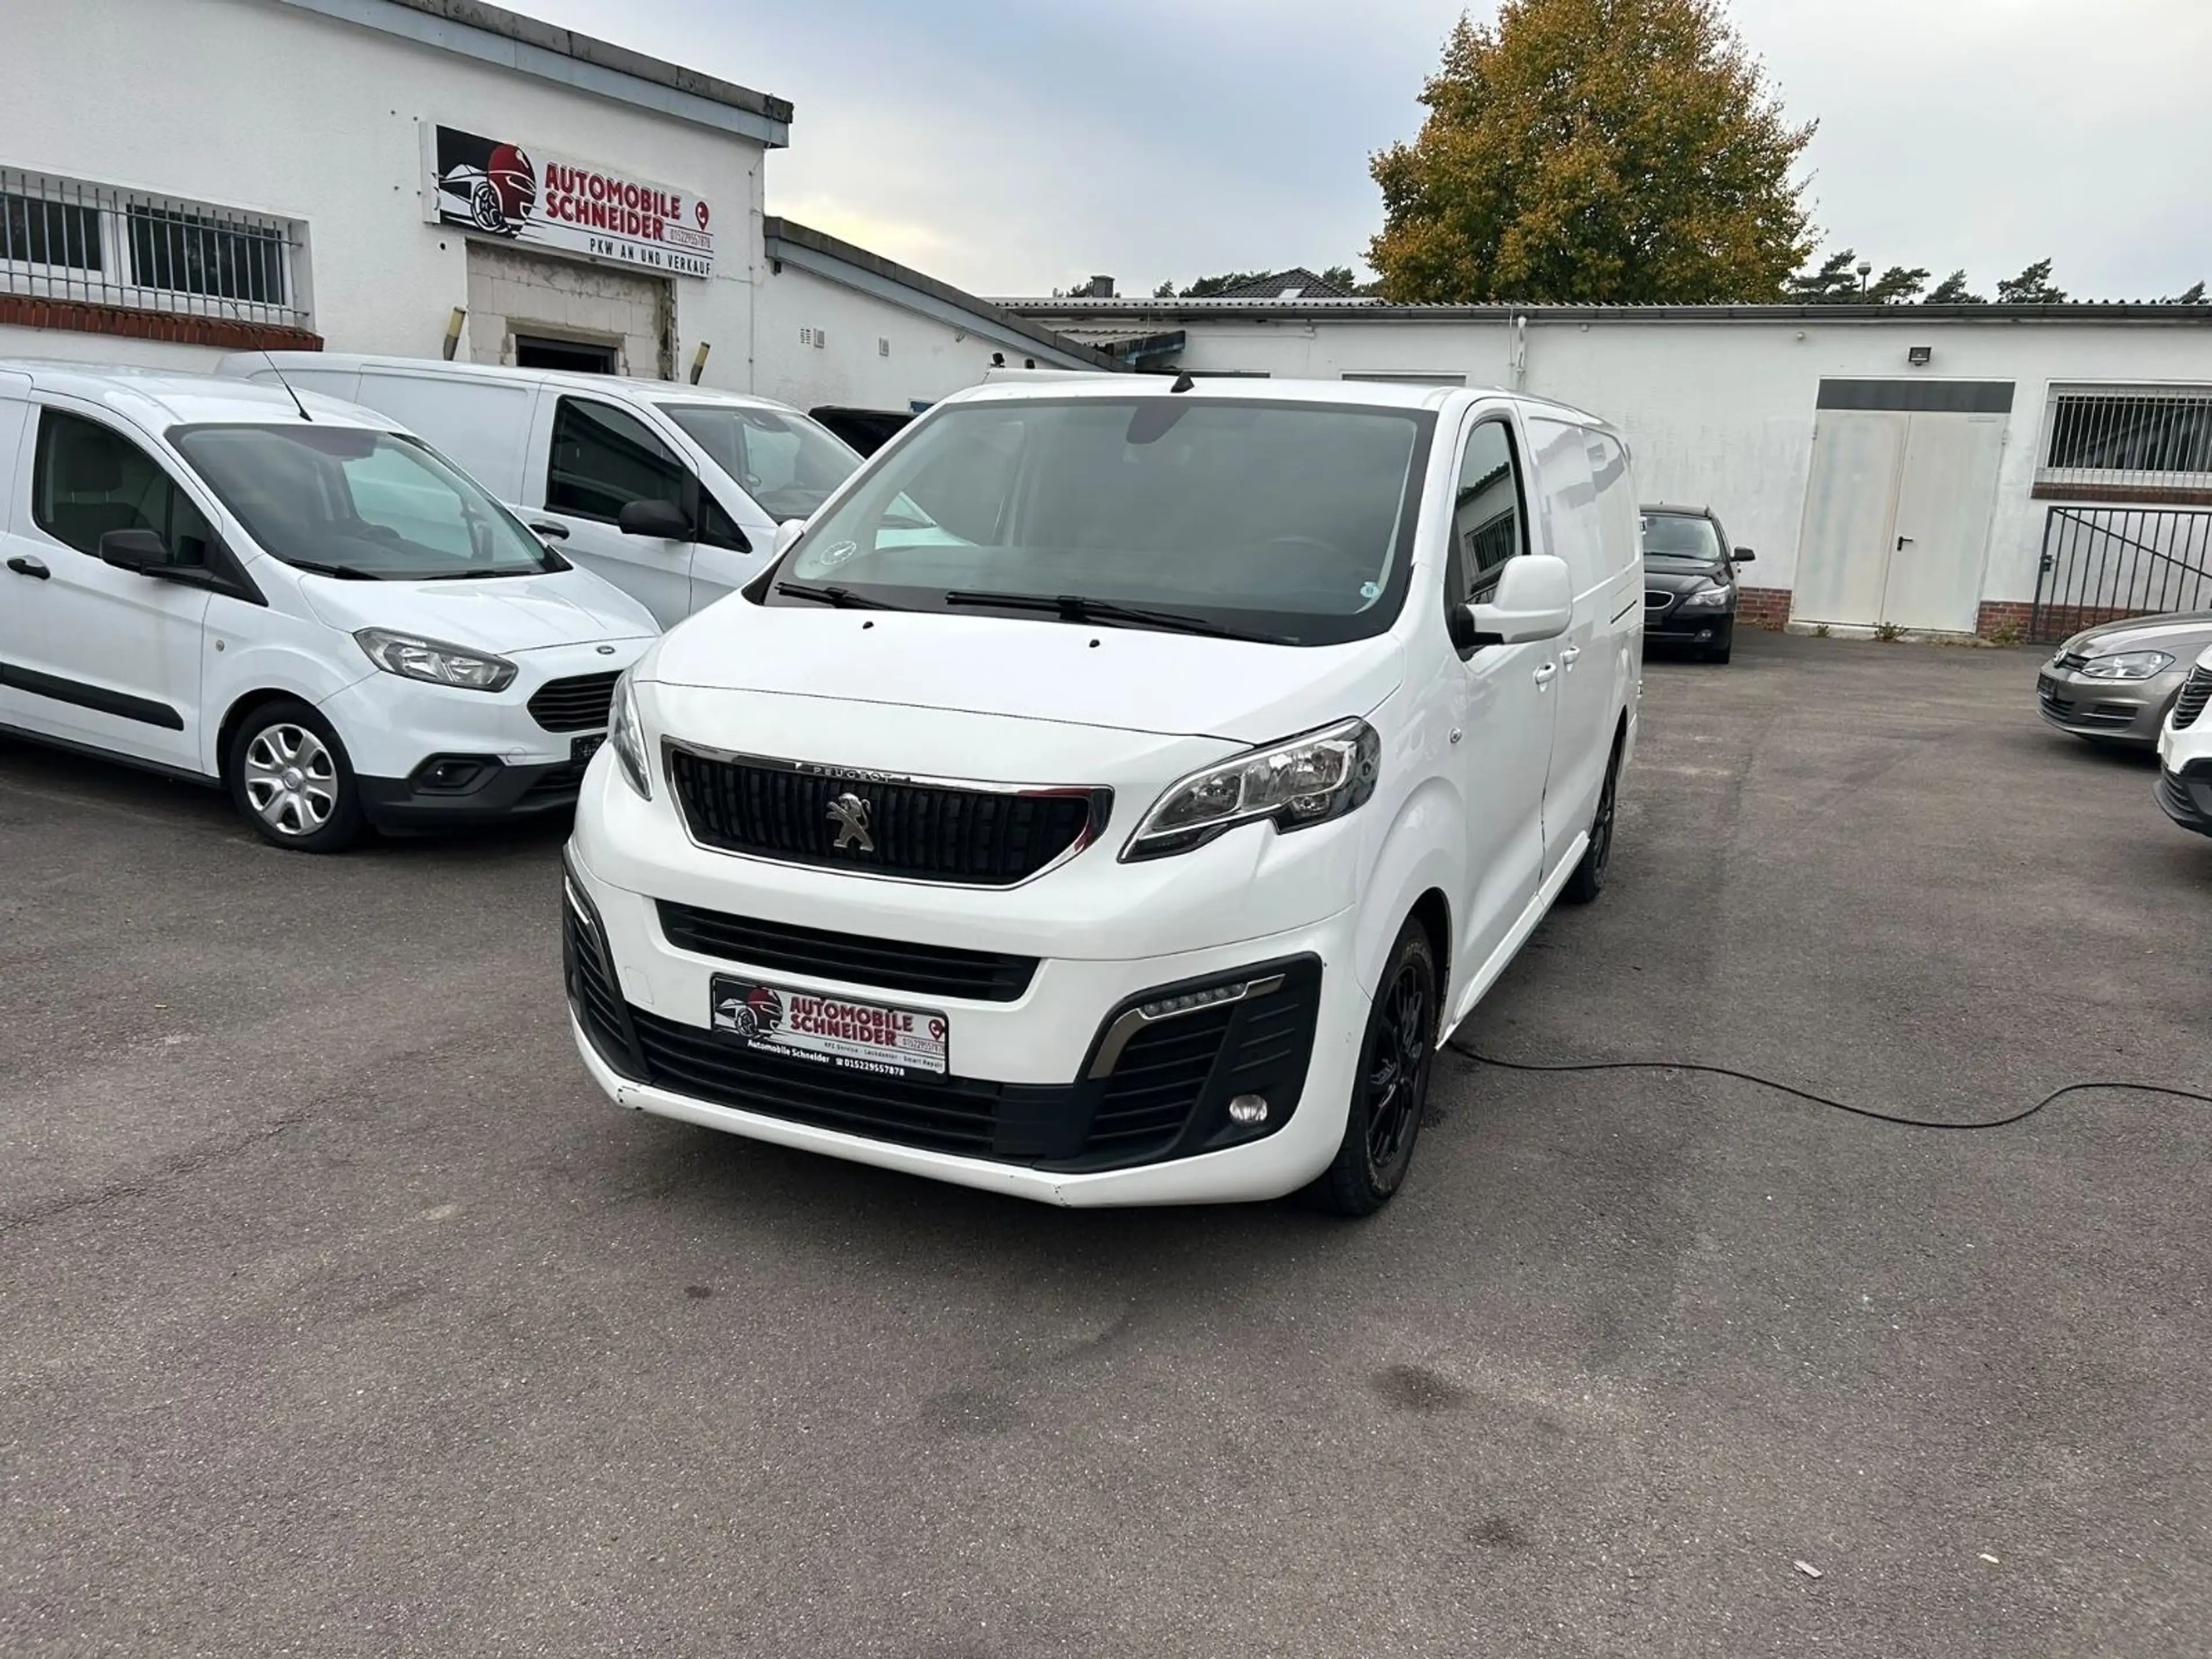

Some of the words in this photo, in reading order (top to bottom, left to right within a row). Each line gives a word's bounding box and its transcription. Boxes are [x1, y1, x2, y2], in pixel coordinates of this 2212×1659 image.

[544, 162, 681, 220] AUTOMOBILE
[545, 192, 664, 241] SCHNEIDER
[590, 237, 613, 256] PKW
[620, 243, 635, 259] AN
[640, 247, 661, 265] UND
[668, 254, 710, 275] VERKAUF
[813, 767, 892, 783] PEUGEOT
[789, 996, 914, 1032] AUTOMOBILE
[790, 1015, 897, 1047] SCHNEIDER
[748, 1039, 790, 1058] Automobile
[792, 1048, 830, 1064] Schneider
